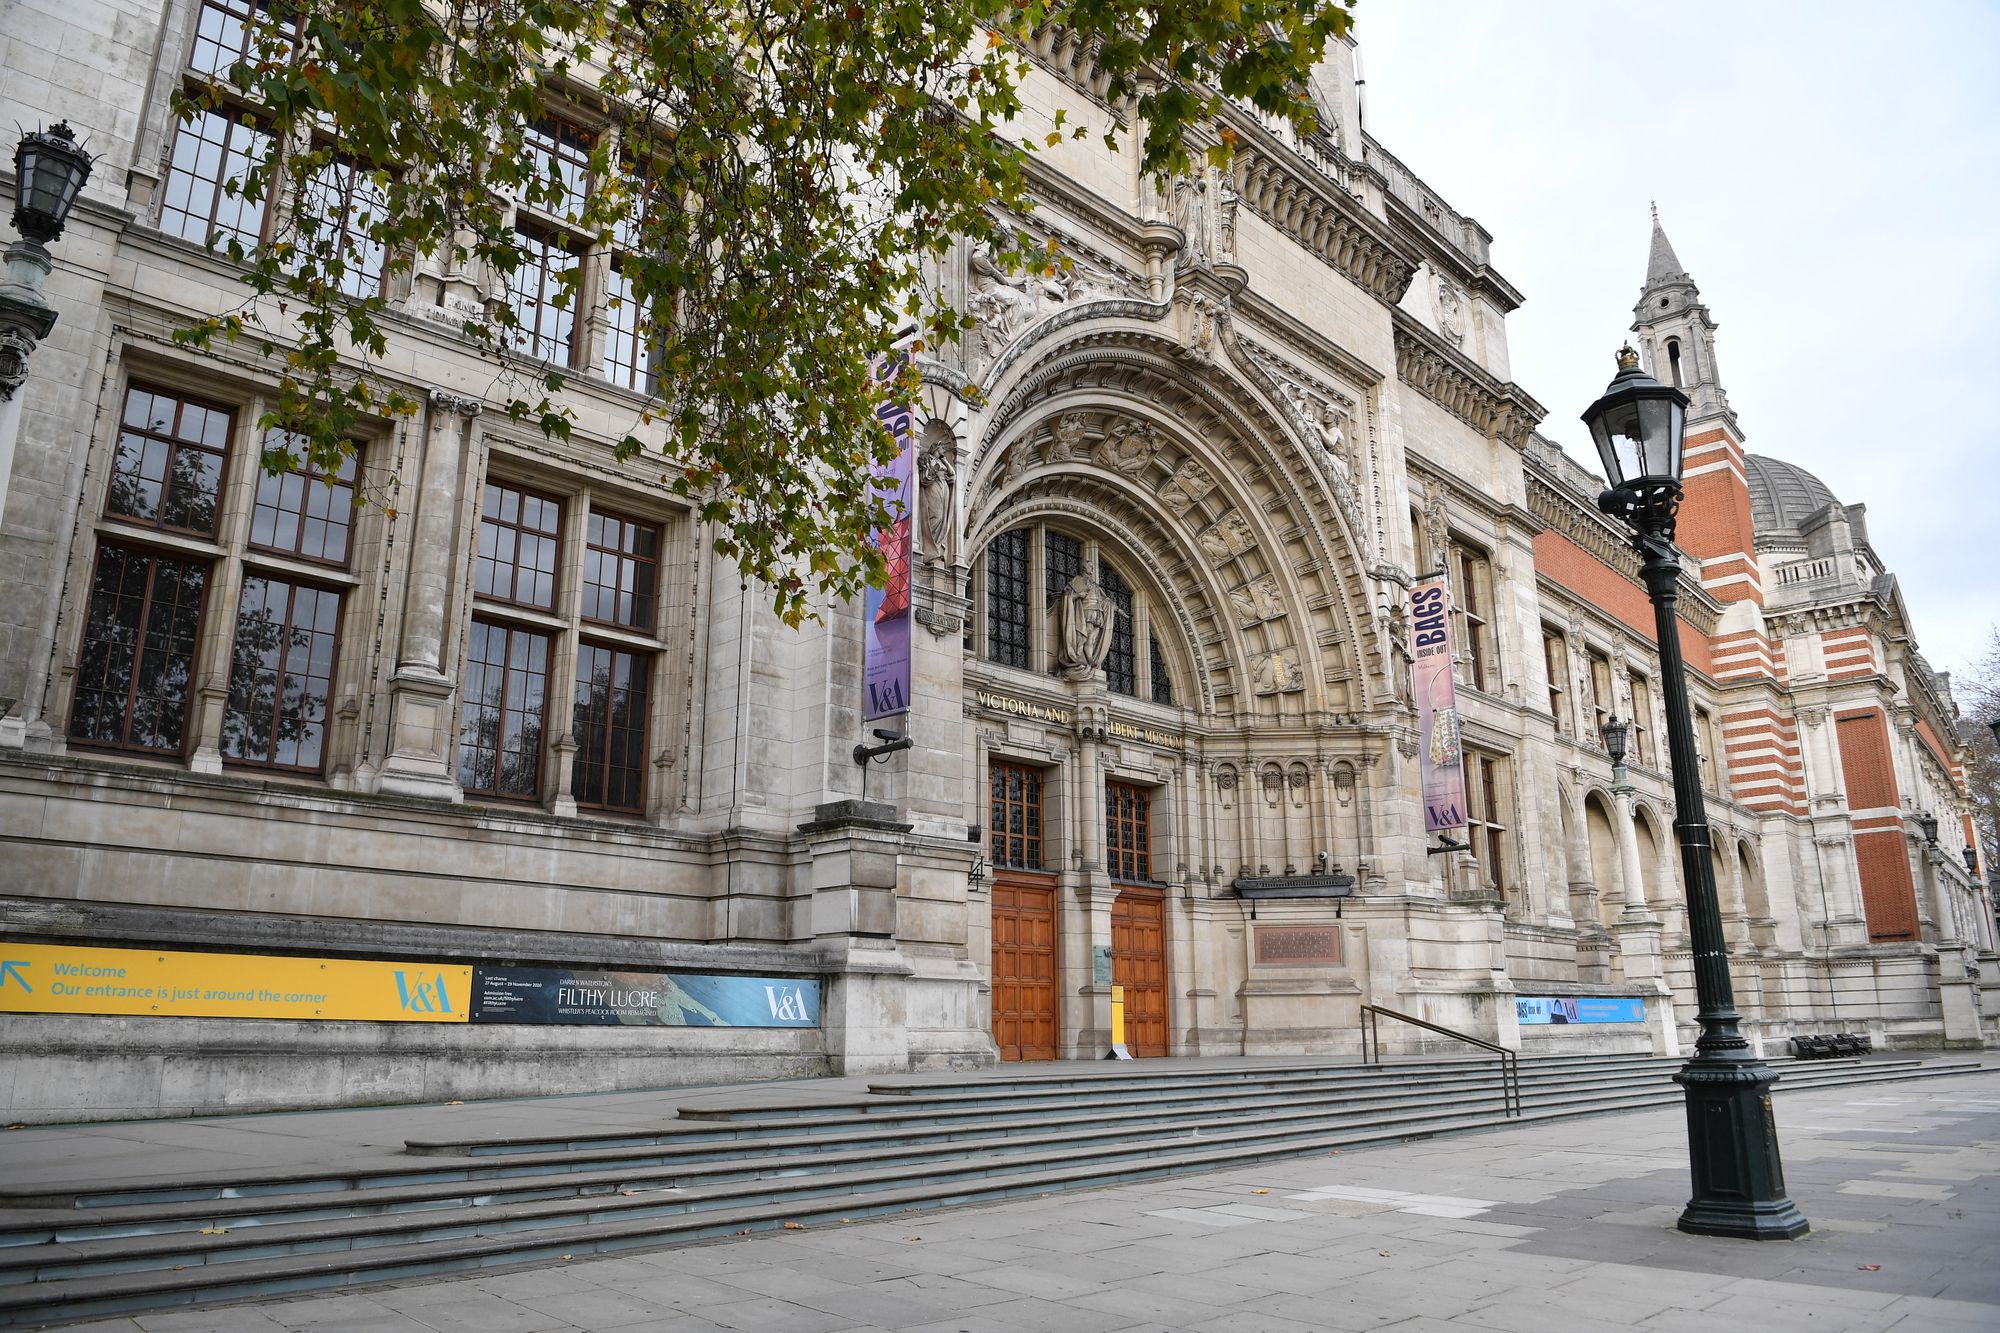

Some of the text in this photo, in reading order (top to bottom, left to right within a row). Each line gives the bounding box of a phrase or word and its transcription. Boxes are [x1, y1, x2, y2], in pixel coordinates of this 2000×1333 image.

[1411, 587, 1446, 647] BAGS
[1416, 644, 1447, 659] INSIDE OUT
[868, 677, 905, 714] V&A
[977, 691, 1070, 724] VICTORIA AND
[1144, 729, 1184, 750] MUSEUM
[1427, 803, 1463, 826] V&A
[53, 962, 127, 978] Welcome
[51, 982, 327, 1004] Our entrance is just around the corner
[392, 970, 454, 1013] V&A
[558, 988, 658, 1008] FILTHY LUCRE
[558, 1007, 585, 1015] WHISTLER'S
[765, 986, 812, 1022] V&A
